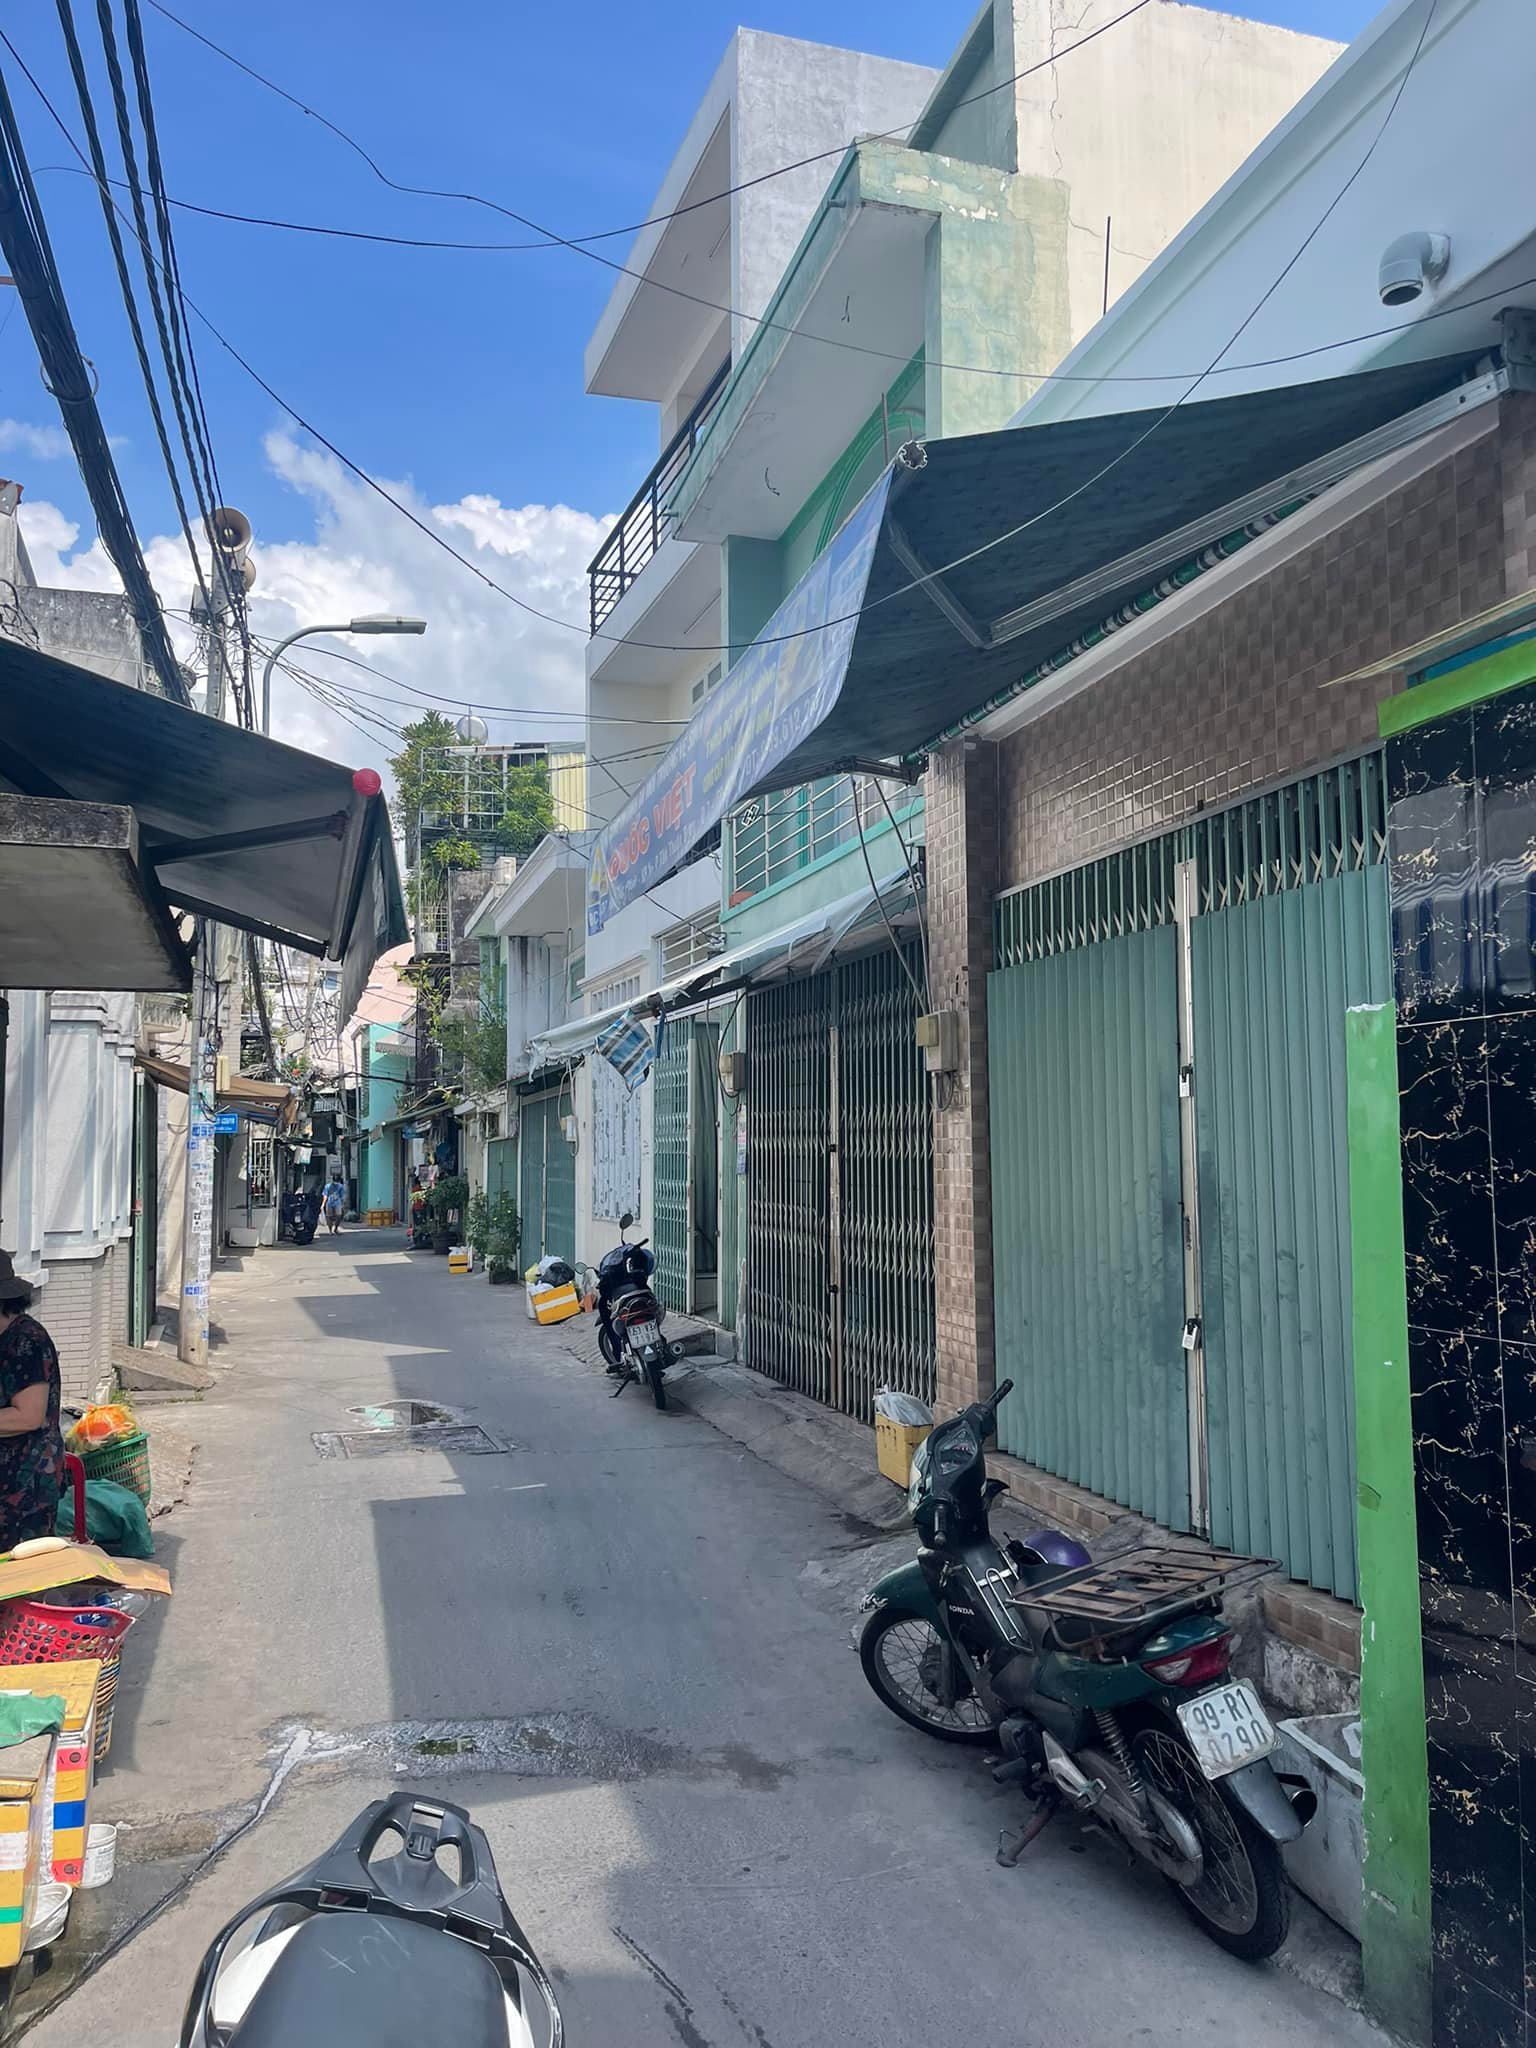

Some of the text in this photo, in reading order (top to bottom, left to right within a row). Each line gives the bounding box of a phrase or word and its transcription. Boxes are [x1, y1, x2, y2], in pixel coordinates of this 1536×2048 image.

[653, 761, 697, 837] VIỆT
[1193, 1688, 1253, 1733] 99-R1
[1207, 1720, 1268, 1763] 0290
